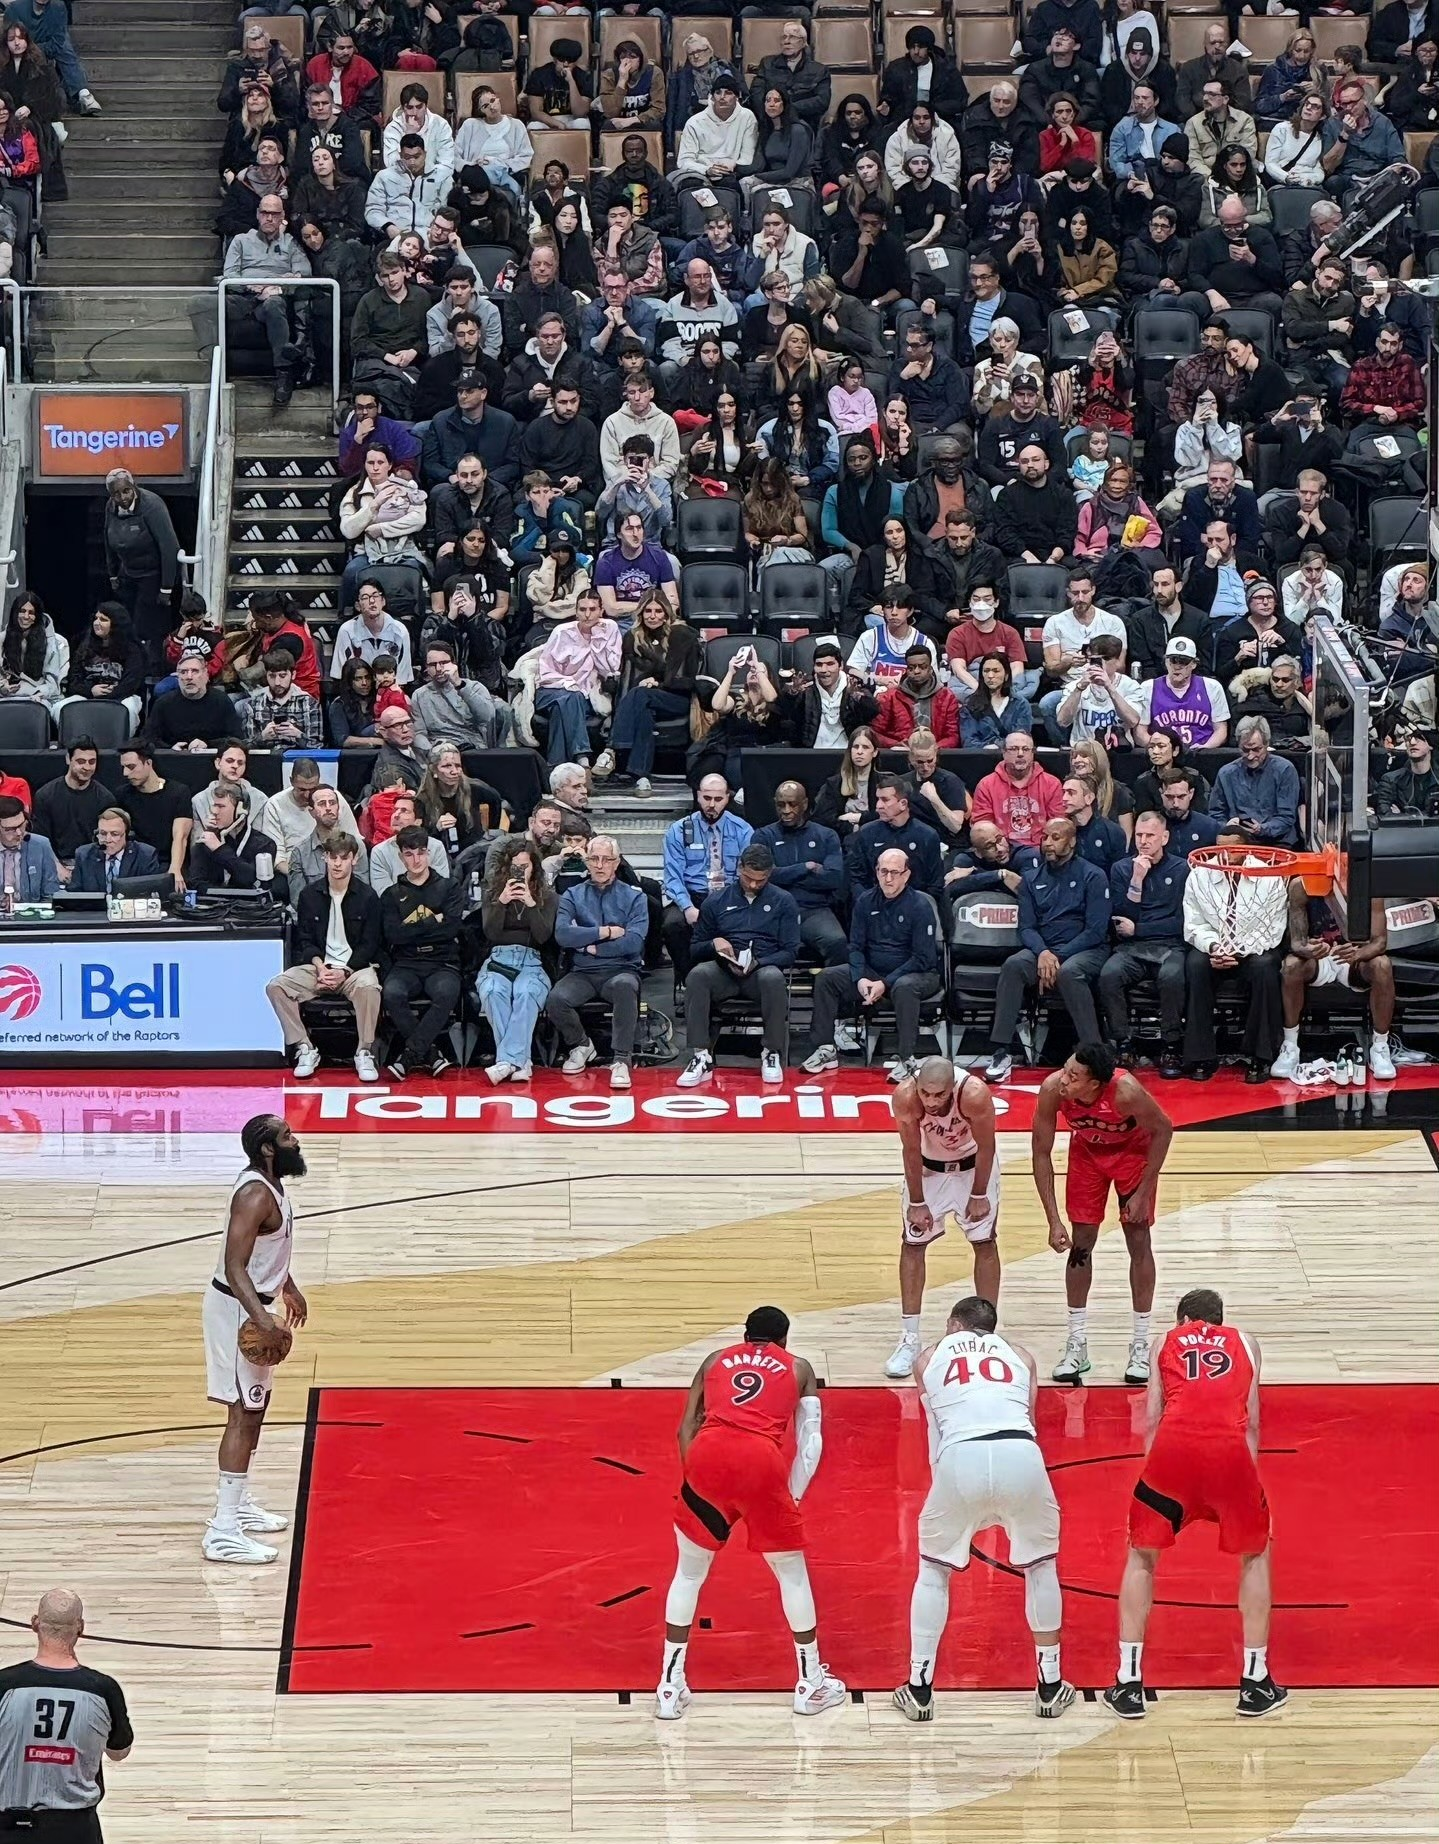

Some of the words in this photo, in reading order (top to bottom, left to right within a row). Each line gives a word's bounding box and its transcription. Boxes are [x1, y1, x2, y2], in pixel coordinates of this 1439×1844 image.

[43, 423, 165, 454] Tangerine
[999, 440, 1016, 459] 15
[1153, 708, 1209, 728] TORONTO
[81, 963, 180, 1019] Bell
[45, 1032, 94, 1042] network
[97, 1031, 110, 1041] of
[112, 1031, 131, 1041] the
[134, 1030, 180, 1042] Raptors
[721, 1353, 787, 1374] BARRETT
[944, 1356, 1013, 1387] 40
[1178, 1348, 1233, 1380] 19
[731, 1370, 764, 1406] 9
[33, 1698, 76, 1741] 37
